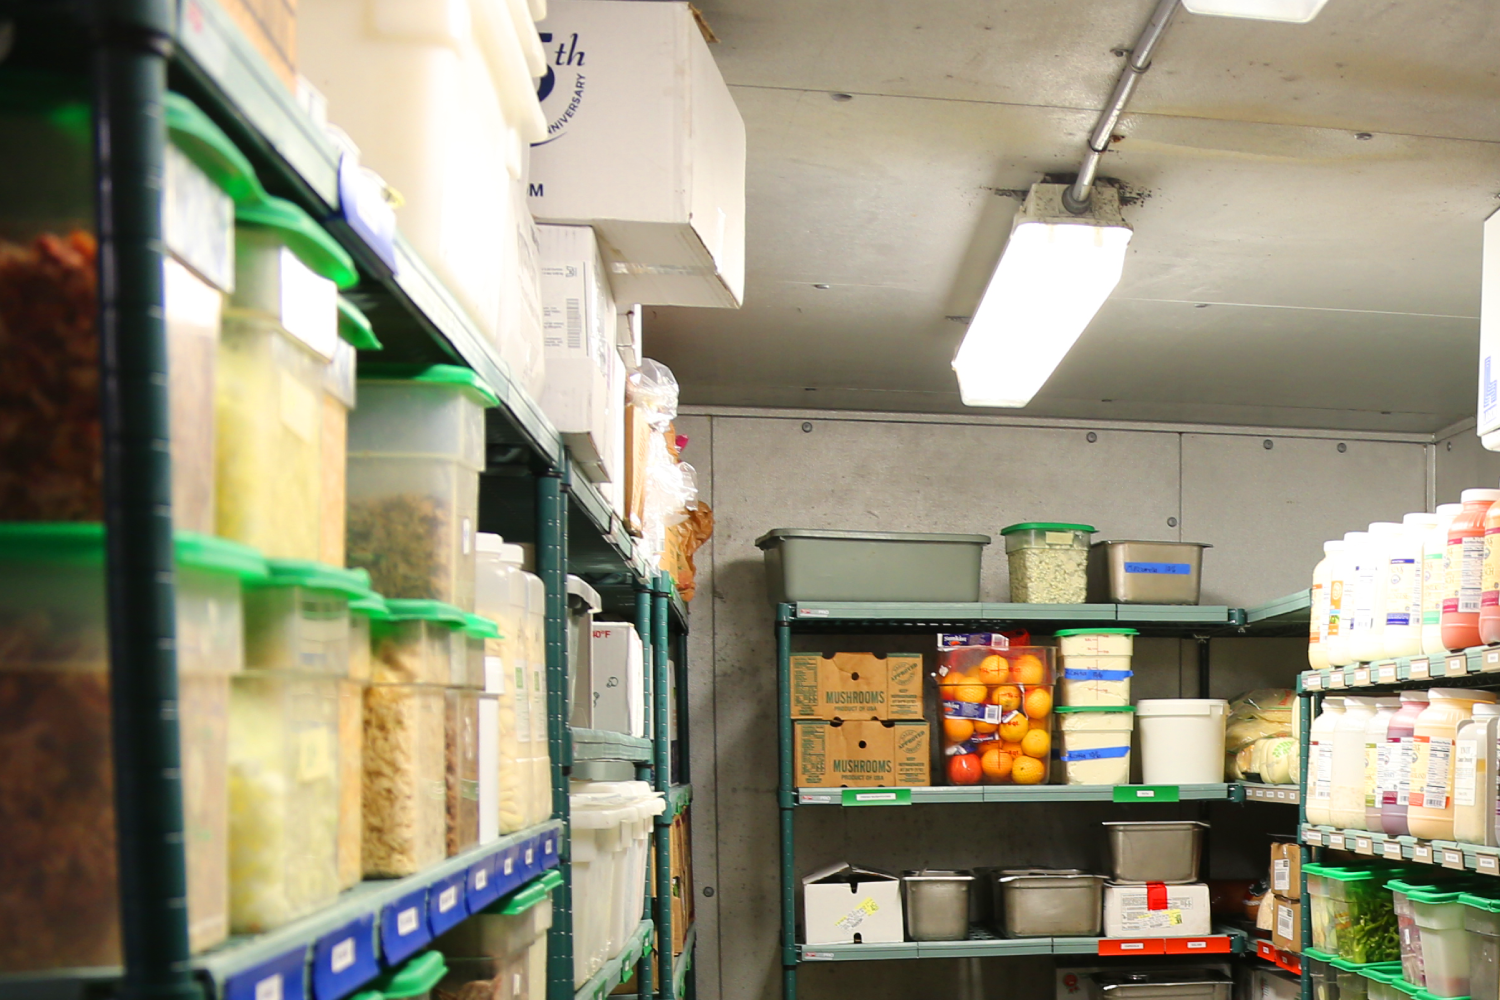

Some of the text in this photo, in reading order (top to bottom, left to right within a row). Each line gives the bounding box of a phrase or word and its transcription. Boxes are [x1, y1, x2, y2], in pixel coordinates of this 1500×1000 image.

[547, 73, 586, 134] NNIVERSARY
[526, 183, 544, 197] M
[826, 691, 884, 703] MUSHROOMS
[833, 760, 892, 772] MUSHROOMS
